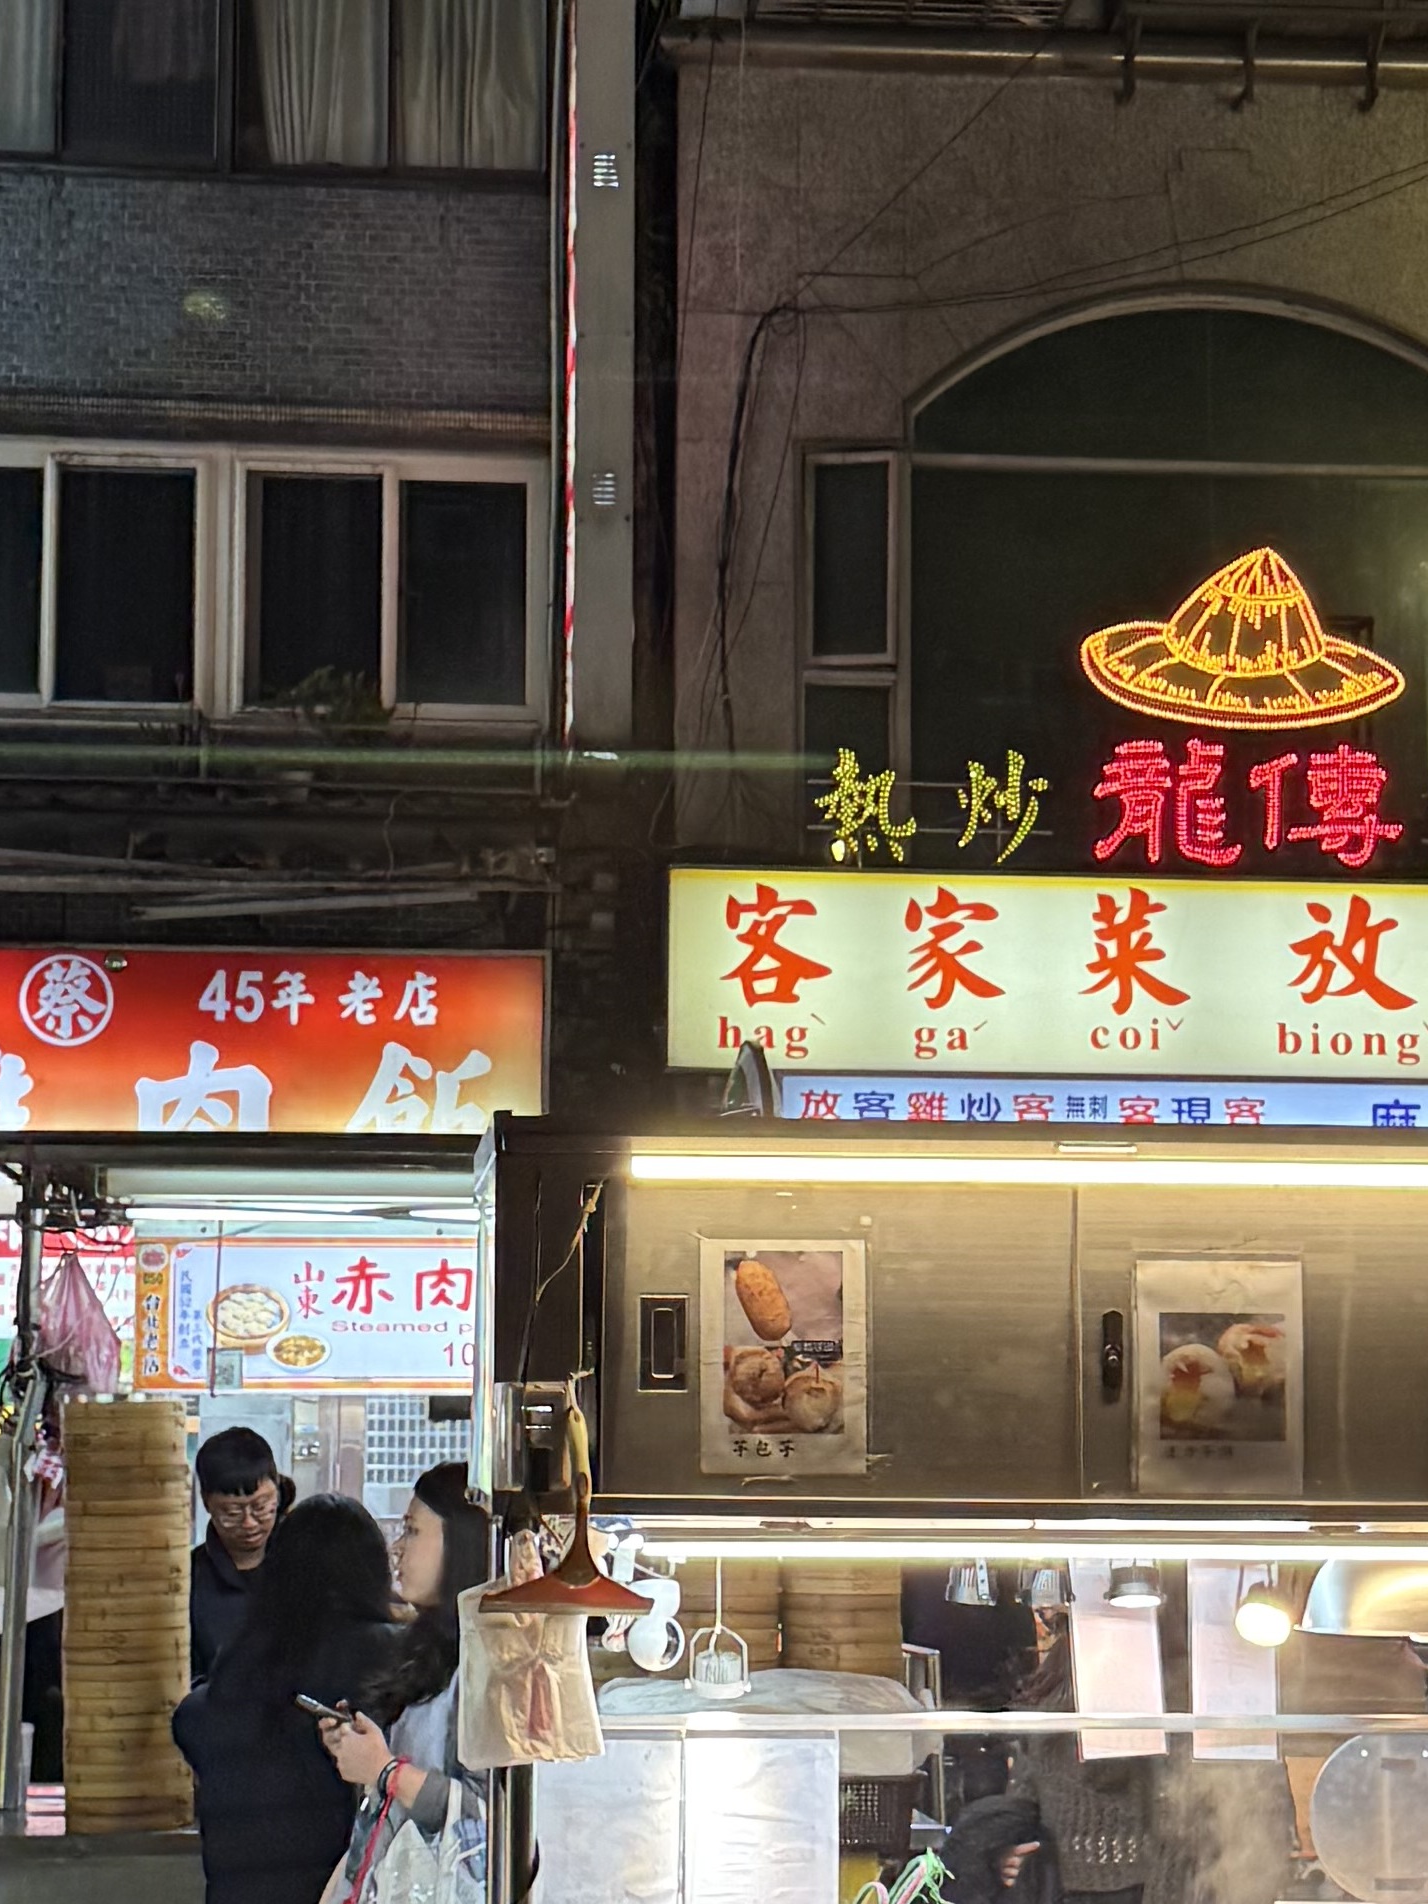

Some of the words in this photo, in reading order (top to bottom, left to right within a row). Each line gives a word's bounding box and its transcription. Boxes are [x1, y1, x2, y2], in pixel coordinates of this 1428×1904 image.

[813, 748, 1048, 863] 熱炒
[1095, 737, 1403, 868] 龍傳
[36, 961, 101, 1041] 蔡
[198, 969, 316, 1027] 45年
[338, 970, 439, 1028] 老店
[293, 1260, 325, 1319] 山東
[332, 1319, 448, 1333] Steamed
